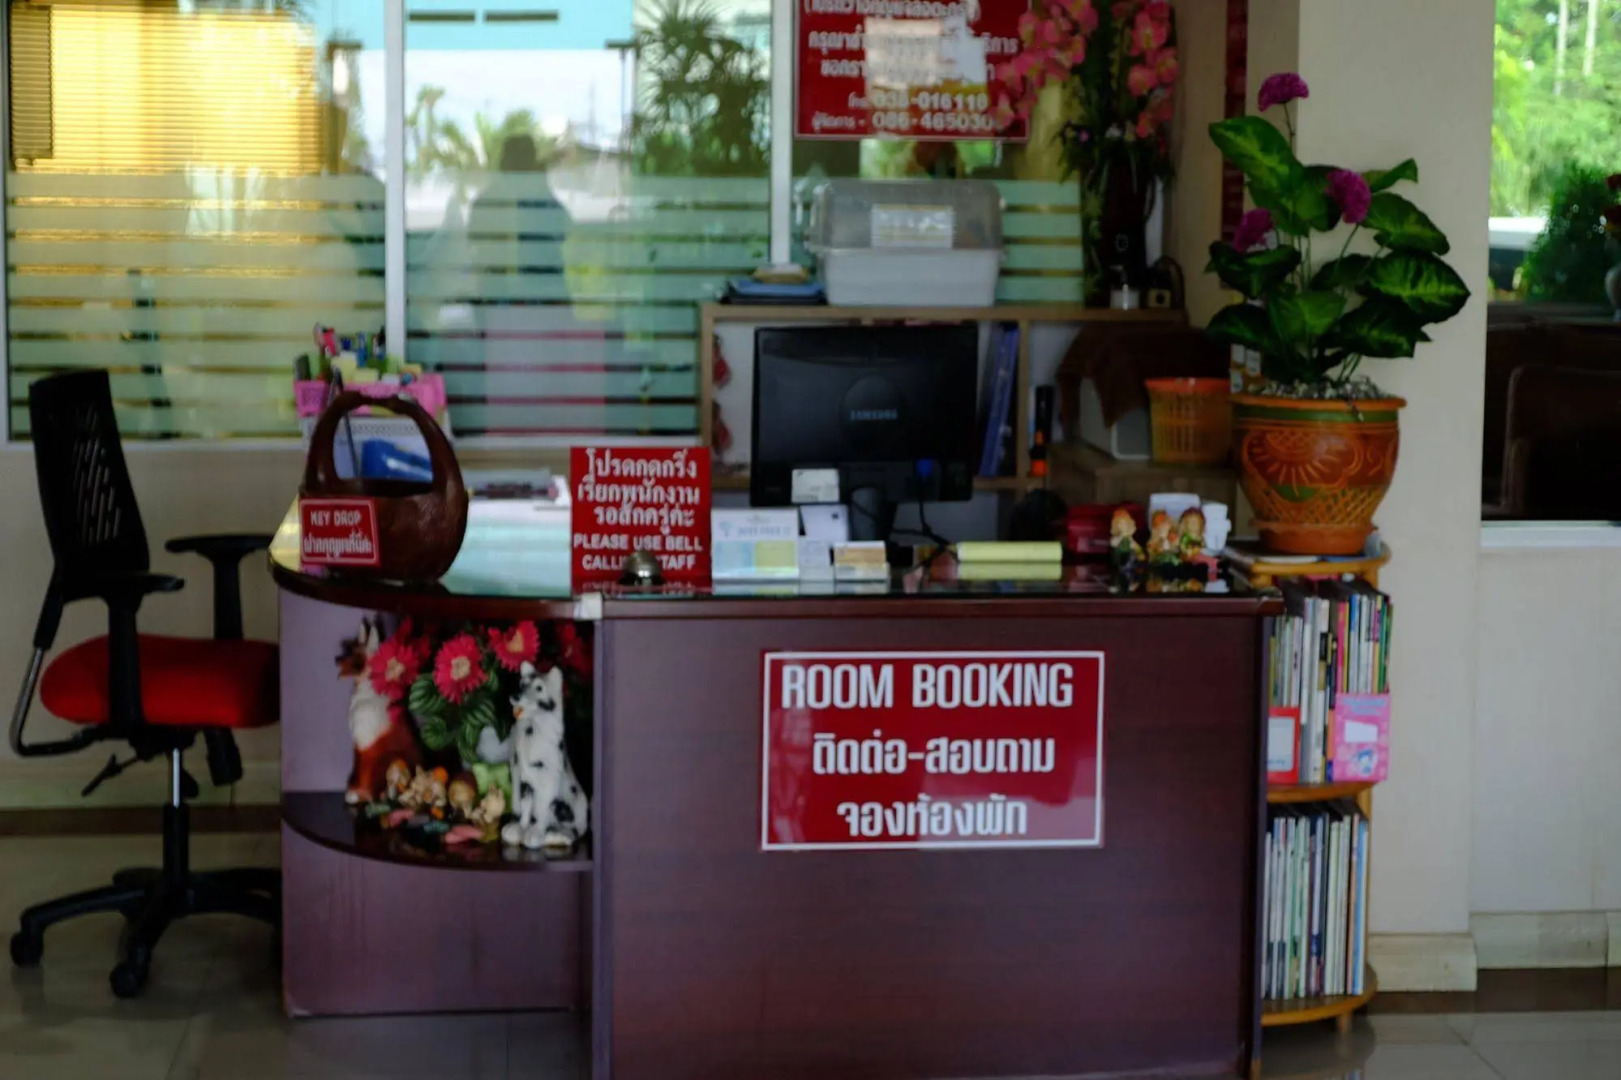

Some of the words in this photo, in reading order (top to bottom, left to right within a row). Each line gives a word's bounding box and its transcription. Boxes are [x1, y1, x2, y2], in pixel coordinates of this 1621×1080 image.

[577, 473, 701, 505] เรียกพนักงาน
[310, 510, 331, 527] KEY
[333, 509, 363, 527] DROP
[573, 533, 630, 550] PLEASE
[633, 535, 662, 551] USE
[665, 535, 703, 551] BELL
[781, 664, 894, 709] ROOM
[912, 663, 1074, 708] BOOKING
[813, 728, 1056, 775] ติดต่อ-สอบถาม
[836, 793, 1028, 837] จองห้องพัก
